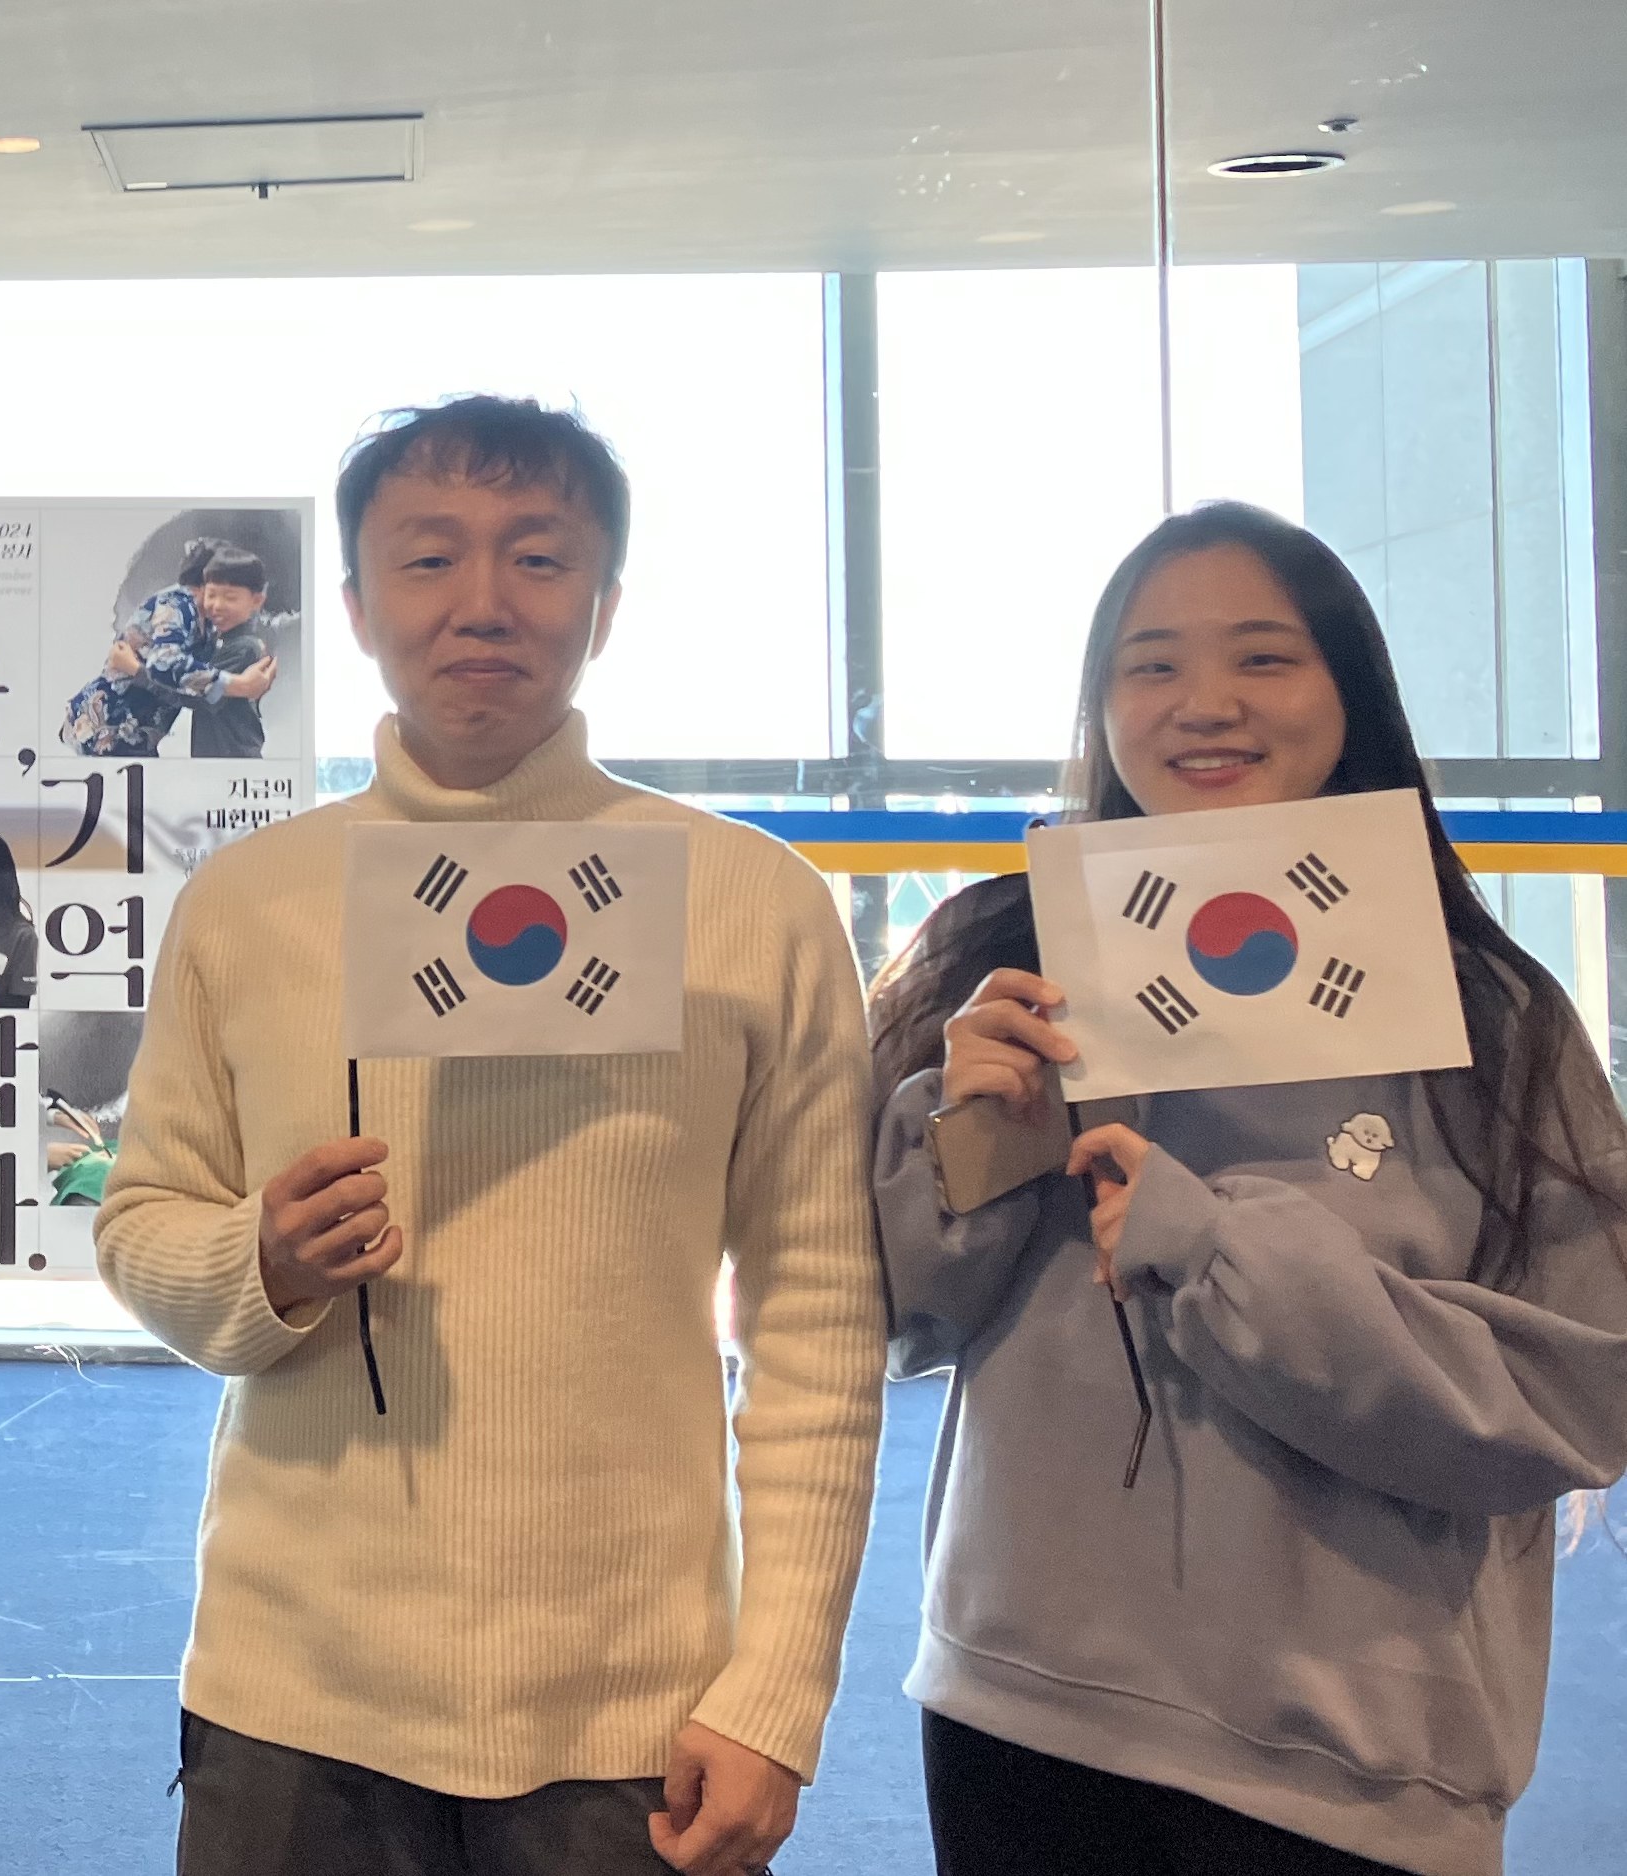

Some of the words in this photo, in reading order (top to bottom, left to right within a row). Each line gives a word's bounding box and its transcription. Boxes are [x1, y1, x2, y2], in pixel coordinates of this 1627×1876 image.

[40, 763, 145, 875] 기
[227, 777, 293, 800] 지금의
[45, 895, 145, 1008] 억
